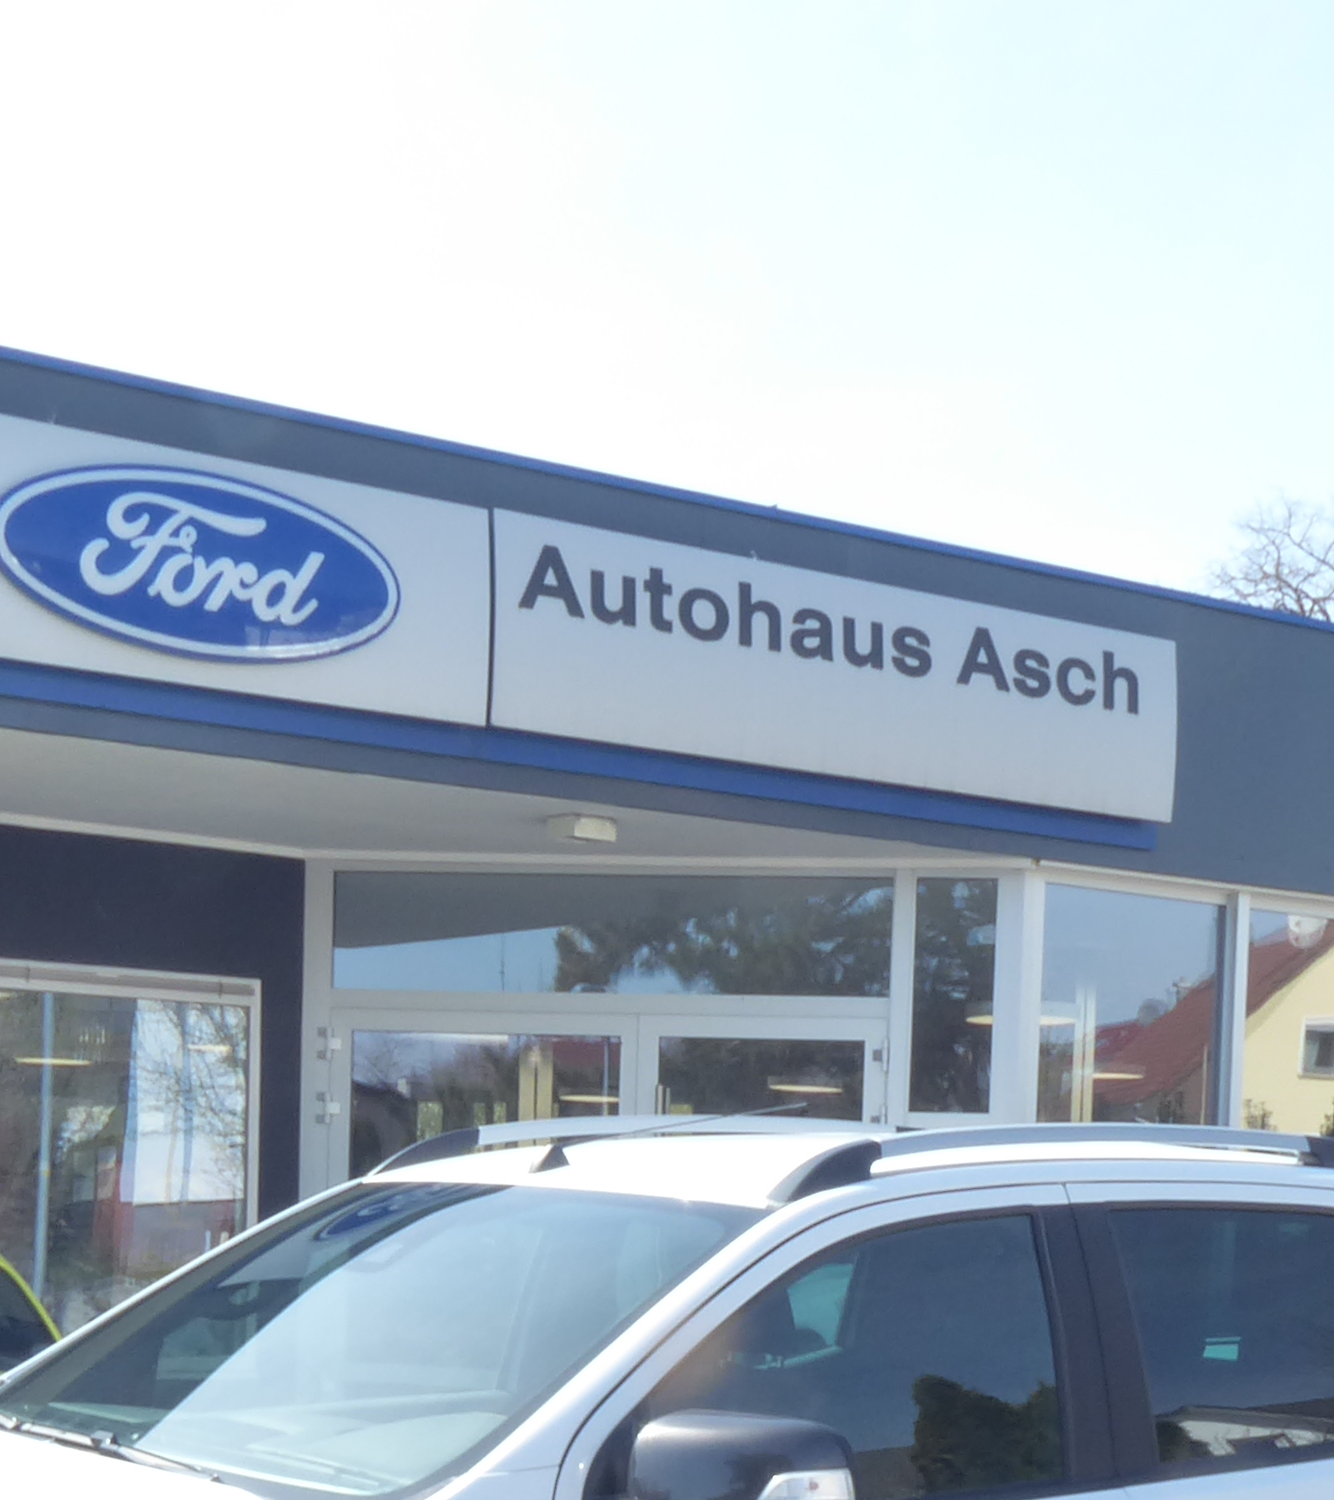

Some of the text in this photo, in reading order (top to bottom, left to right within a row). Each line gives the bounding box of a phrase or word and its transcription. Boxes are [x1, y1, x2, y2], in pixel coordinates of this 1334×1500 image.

[79, 490, 325, 626] Ford
[518, 544, 1140, 715] Autohaus Asch
